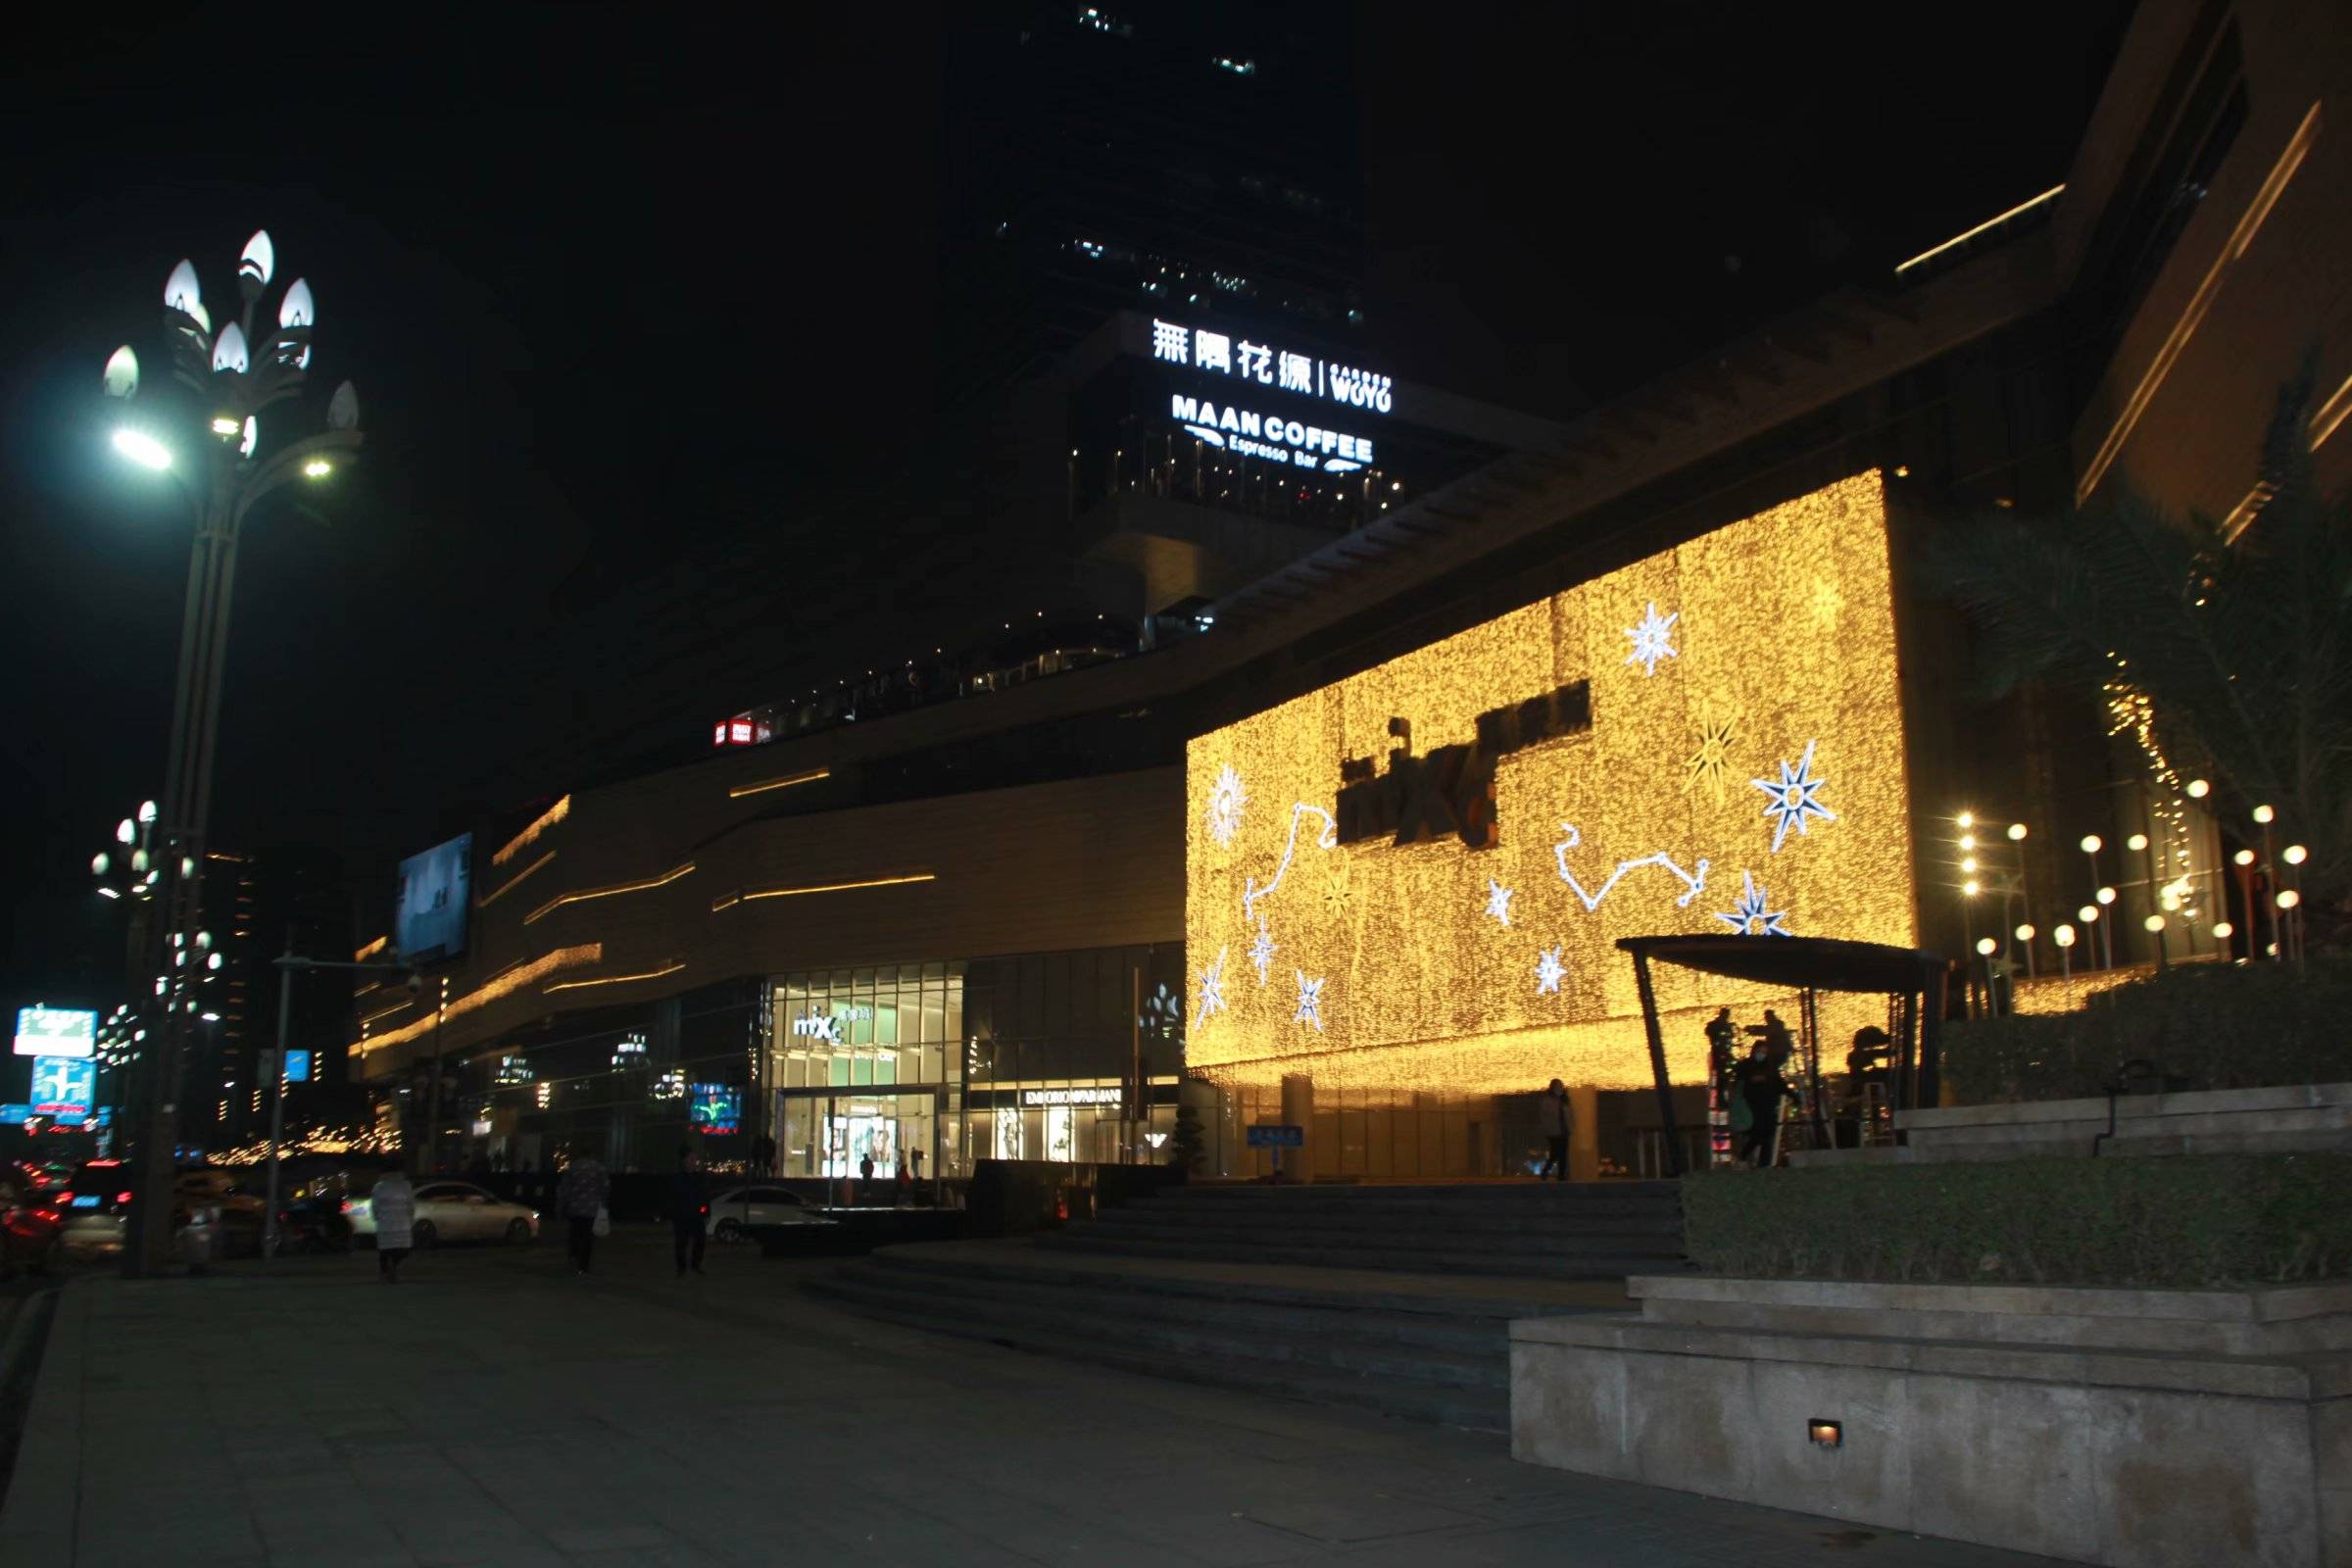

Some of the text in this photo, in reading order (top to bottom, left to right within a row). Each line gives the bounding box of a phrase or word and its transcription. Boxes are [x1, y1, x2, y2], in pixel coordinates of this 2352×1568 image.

[1172, 394, 1373, 463] MAAN COFFEE
[1229, 434, 1318, 468] Espresso Bar
